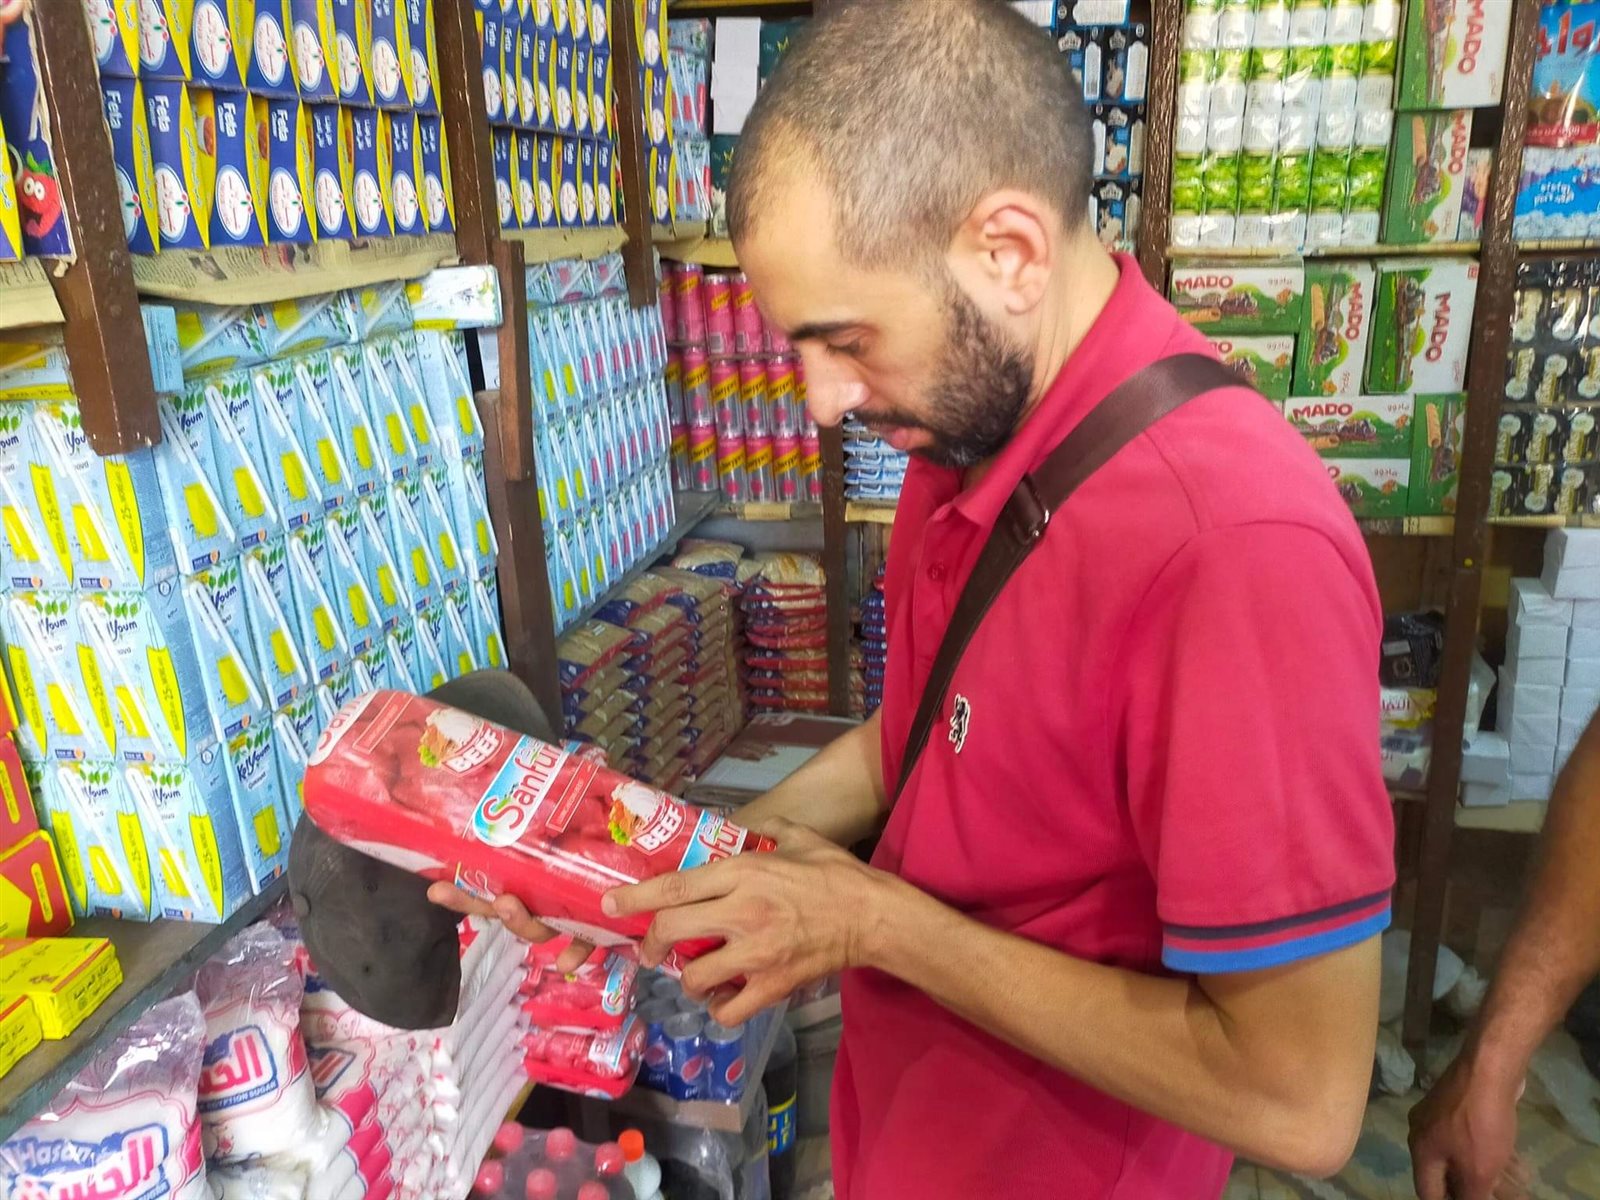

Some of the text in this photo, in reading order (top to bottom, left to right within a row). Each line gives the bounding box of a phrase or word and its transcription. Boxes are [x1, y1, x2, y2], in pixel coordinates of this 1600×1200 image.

[107, 90, 121, 129] Feta
[154, 95, 170, 133] Feta
[223, 102, 236, 138] Feta
[277, 109, 289, 142] Feta
[1175, 276, 1233, 292] MADO
[1345, 282, 1363, 340] MADO
[1426, 292, 1452, 362] MADO
[1293, 403, 1352, 419] MADO
[66, 431, 86, 456] You
[110, 620, 137, 642] Youm
[452, 727, 501, 775] BEEF
[639, 807, 683, 852] BEEF
